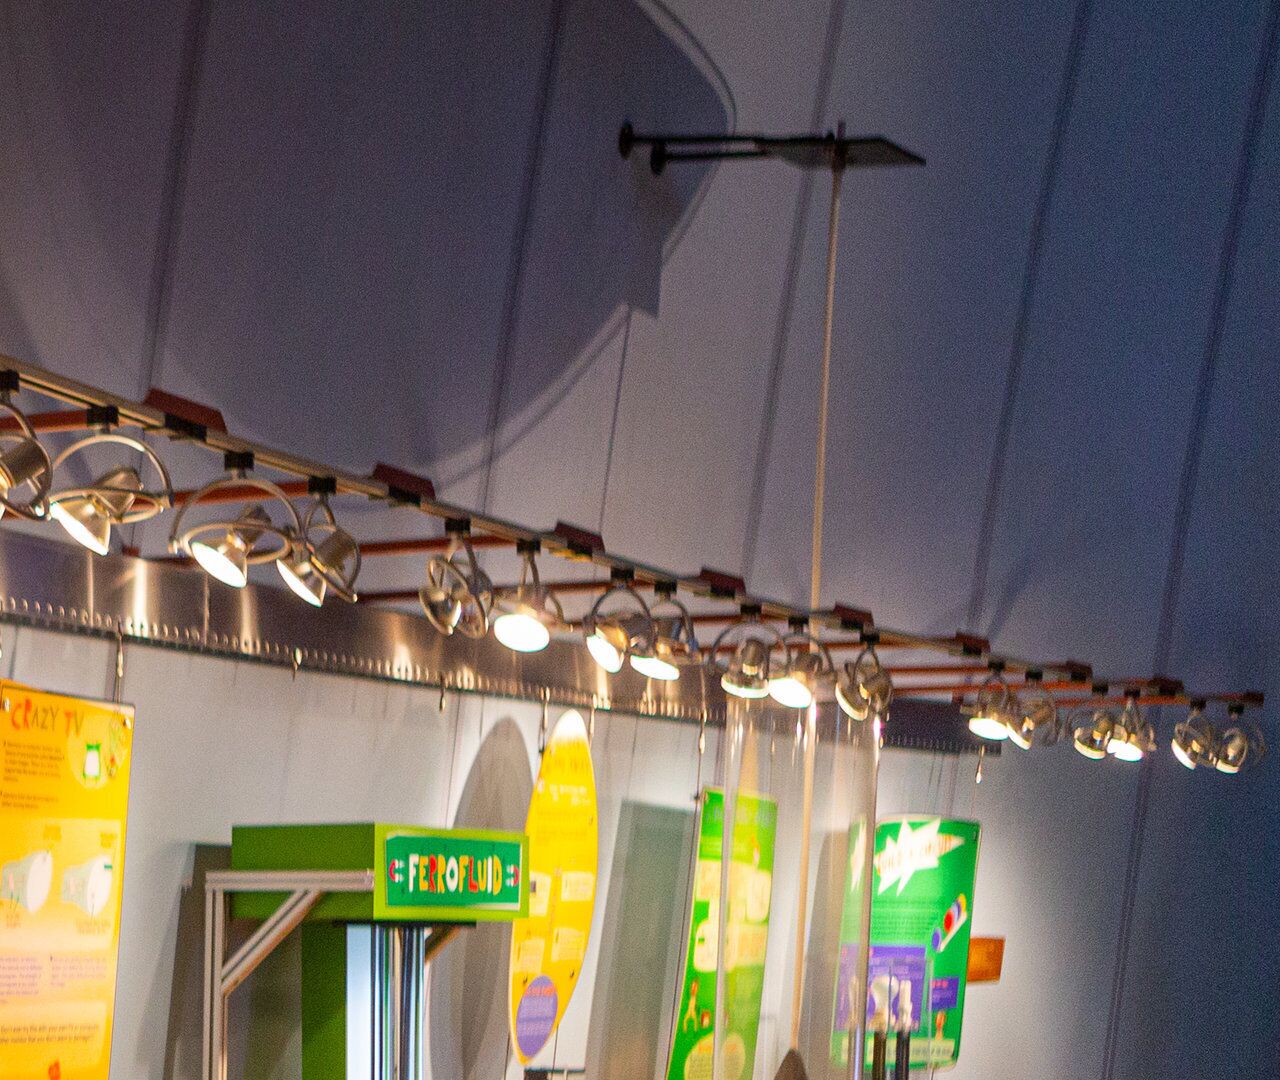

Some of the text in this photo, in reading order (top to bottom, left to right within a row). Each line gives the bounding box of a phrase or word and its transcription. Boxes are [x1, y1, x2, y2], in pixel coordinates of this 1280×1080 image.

[11, 698, 84, 737] CRAZY TV
[408, 853, 503, 896] FERROFLUID
